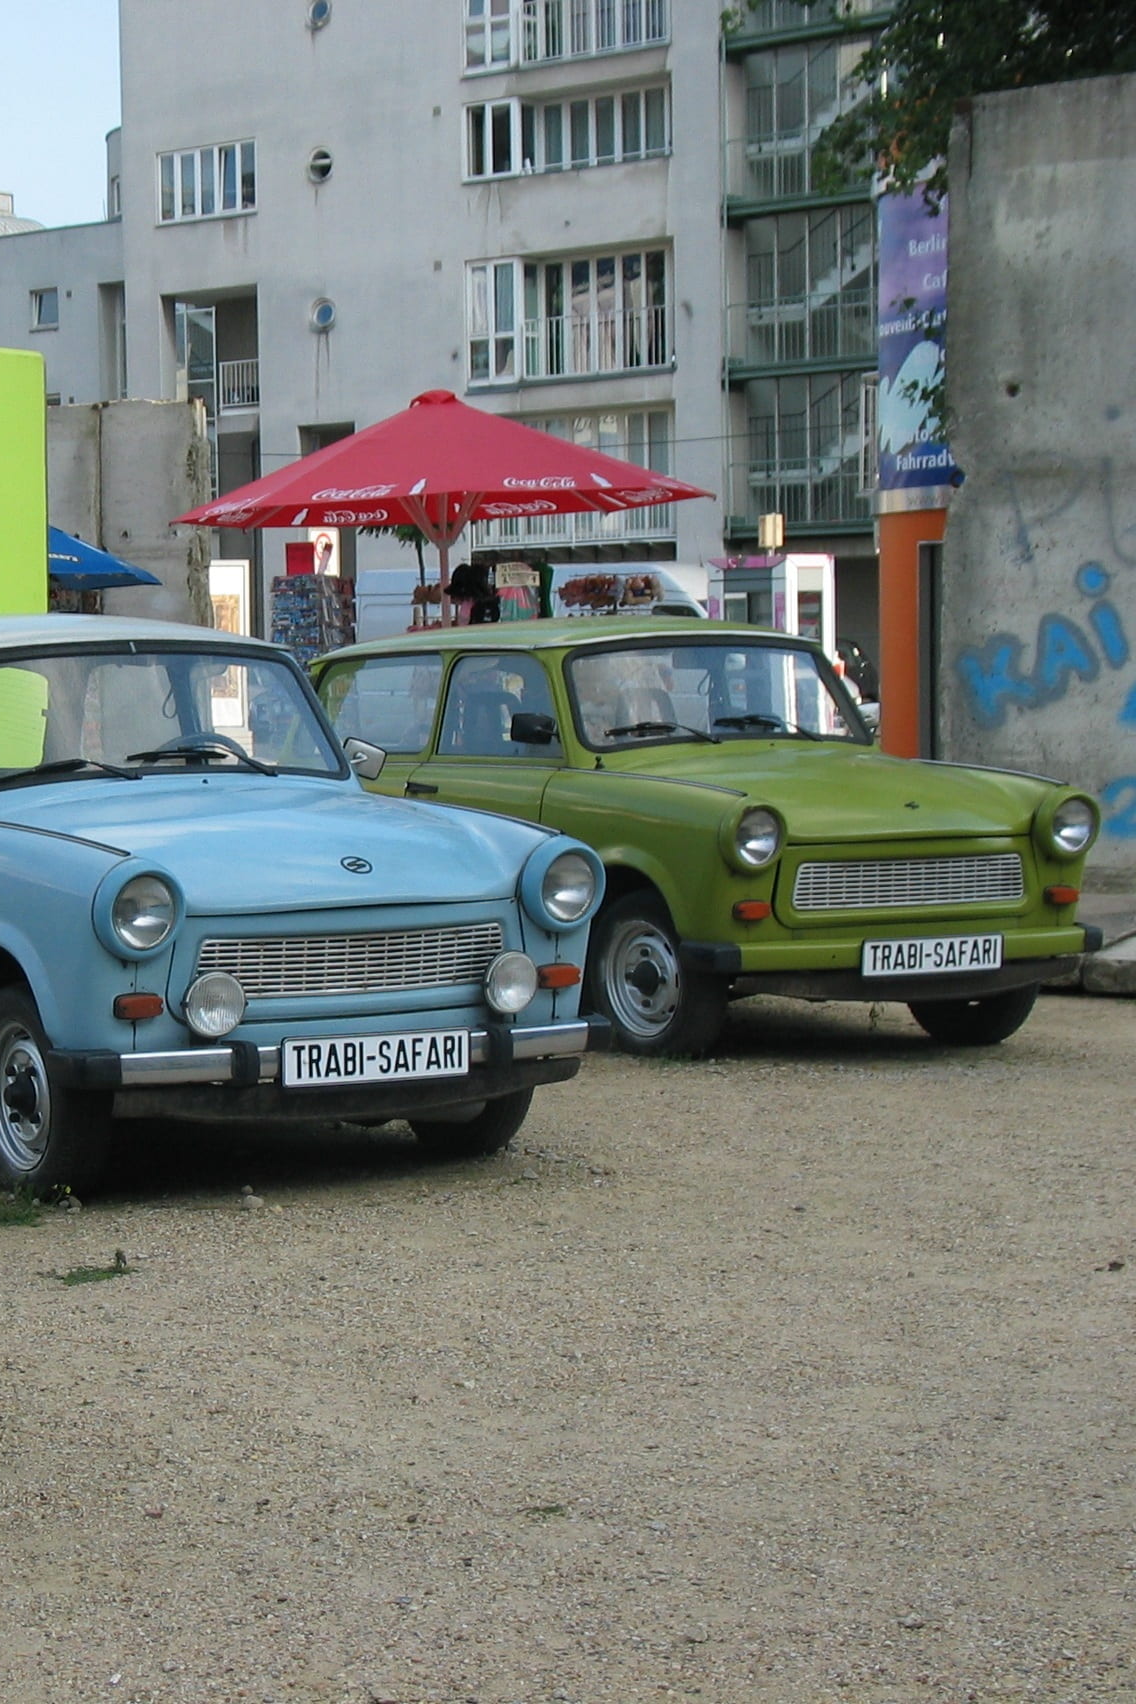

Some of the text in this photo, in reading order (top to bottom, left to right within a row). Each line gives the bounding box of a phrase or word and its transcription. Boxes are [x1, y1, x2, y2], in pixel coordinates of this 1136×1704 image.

[311, 483, 399, 501] Coca-Cola
[503, 476, 577, 489] Coca-Cola
[870, 938, 998, 971] TRABI-SAFARI
[292, 1034, 463, 1079] TRABI-SAFARI
